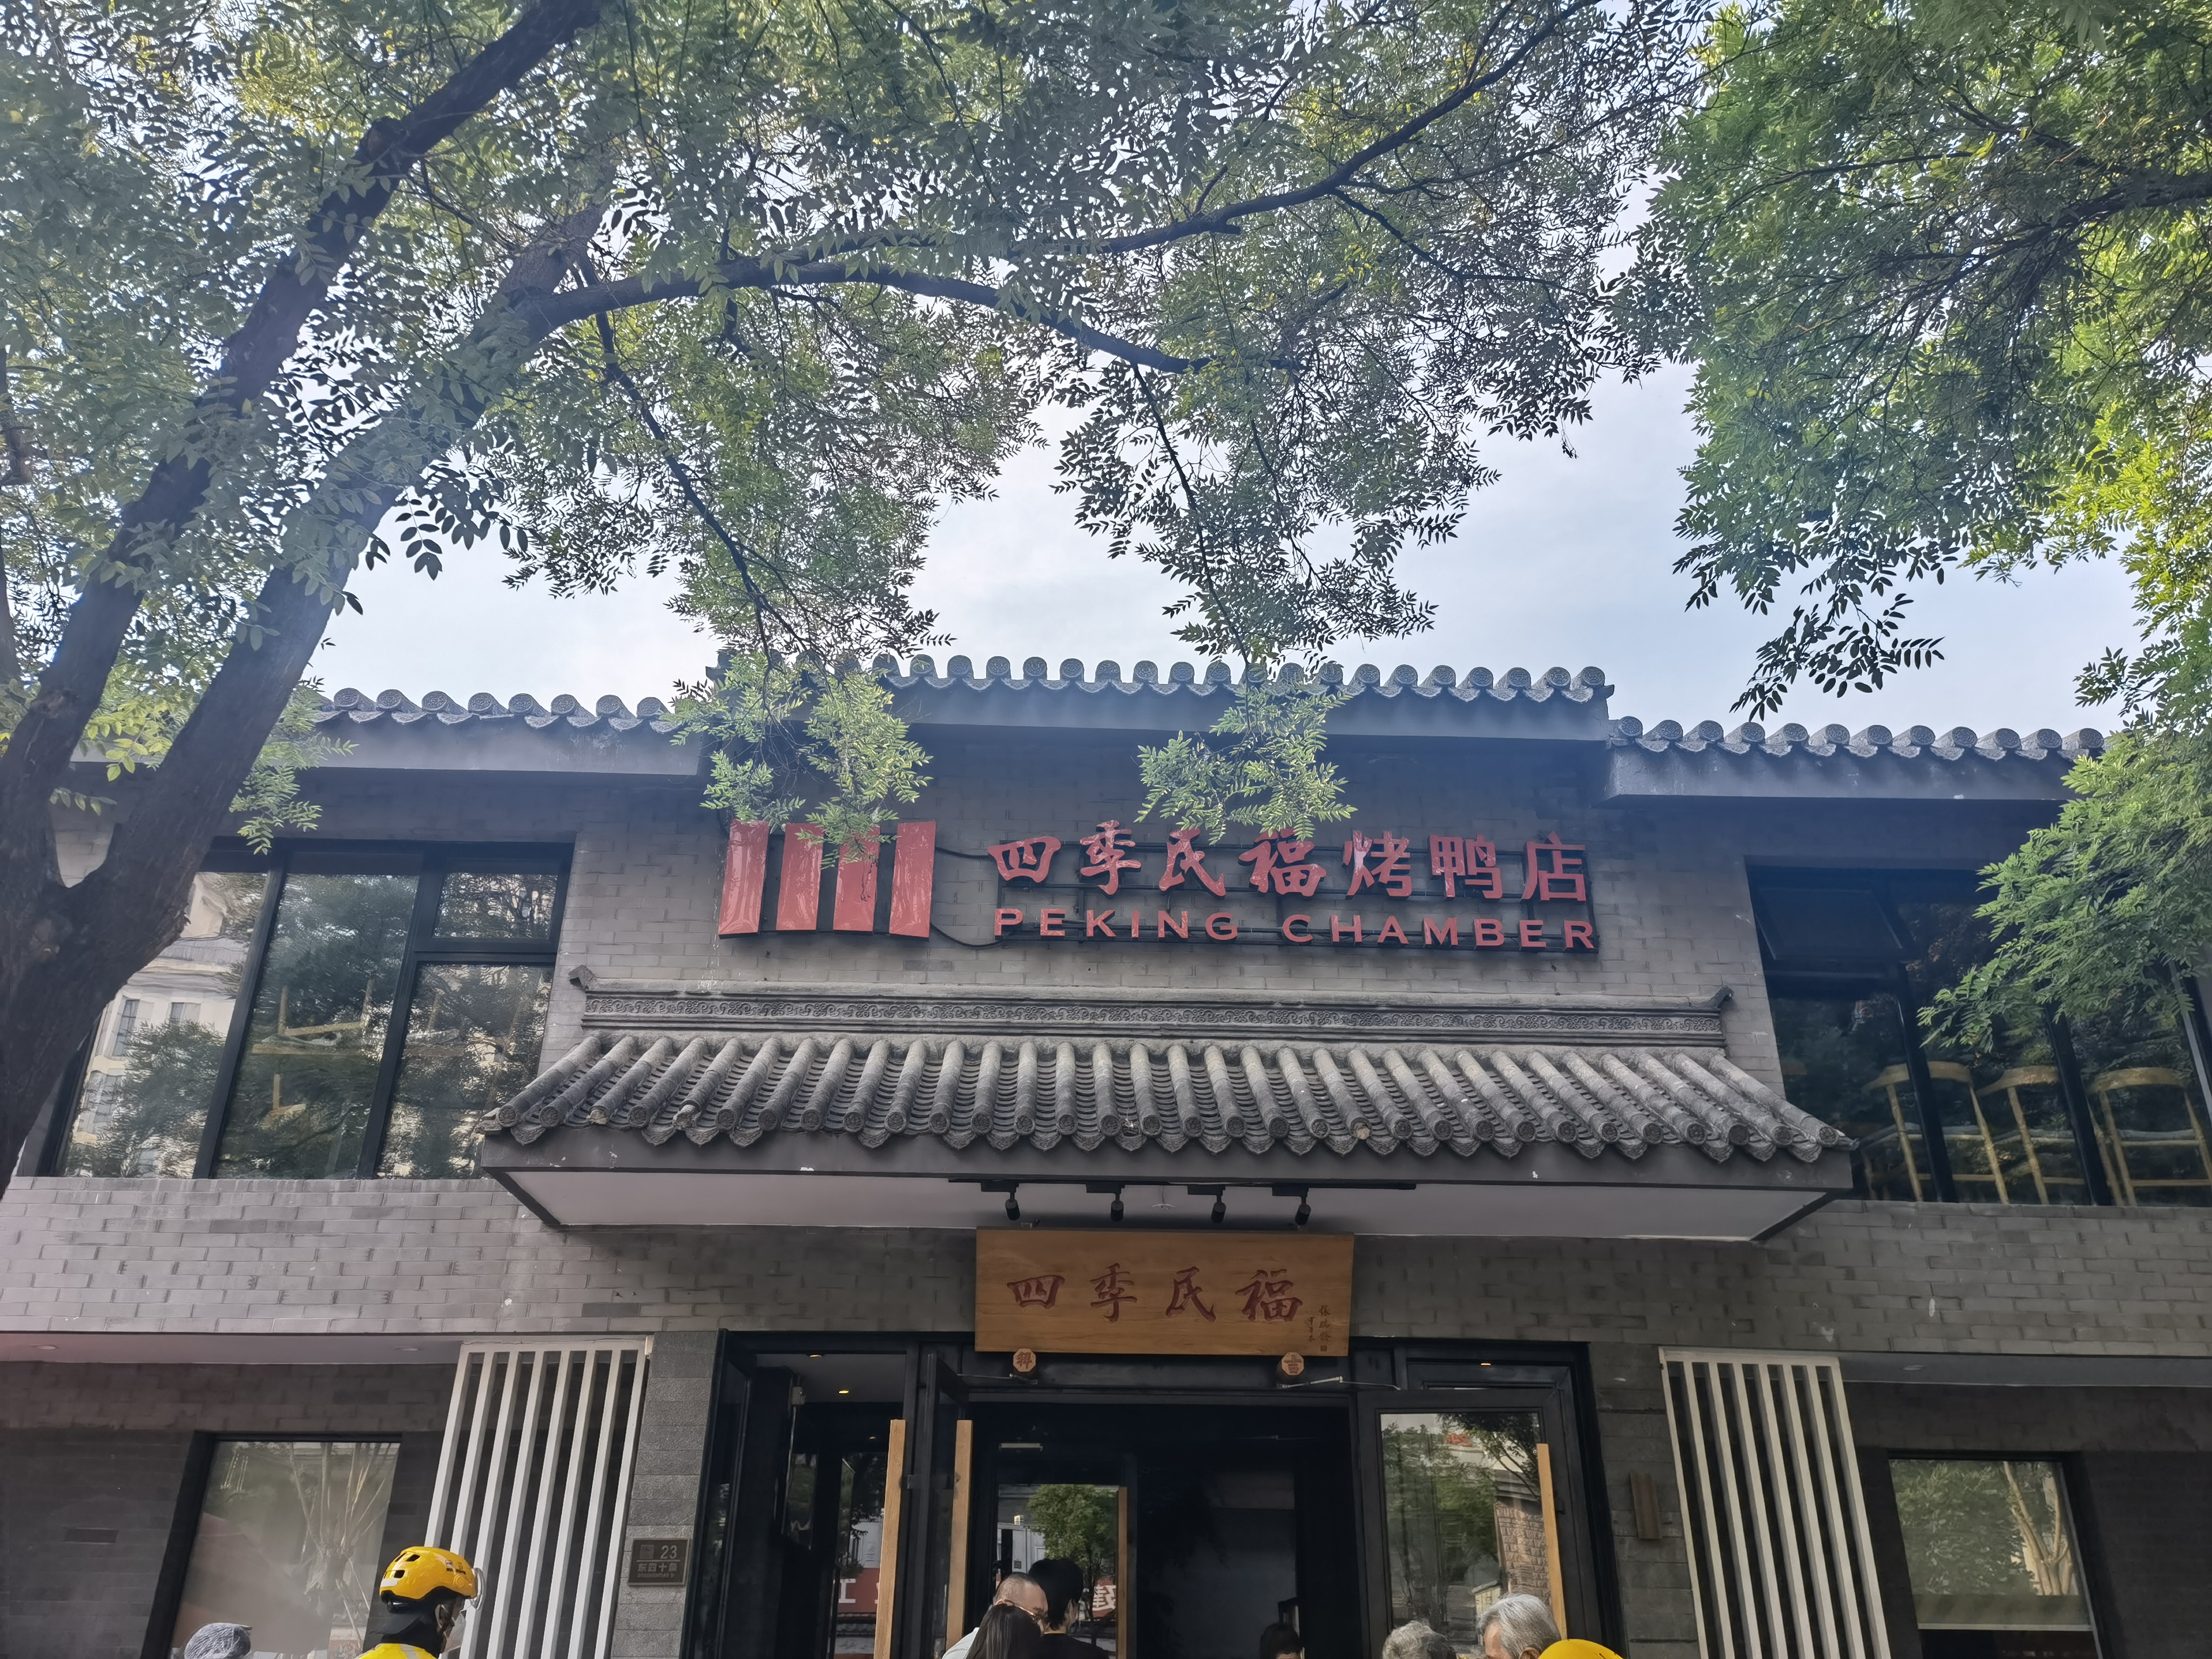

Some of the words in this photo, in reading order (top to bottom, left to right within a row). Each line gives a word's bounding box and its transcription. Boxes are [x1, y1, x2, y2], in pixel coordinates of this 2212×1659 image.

[988, 820, 1586, 901] 四季民福烤鸭店
[994, 908, 1238, 940] PEKING
[1282, 914, 1594, 948] CHAMBER
[1007, 1263, 1303, 1323] 四季民福
[660, 1545, 677, 1559] 23
